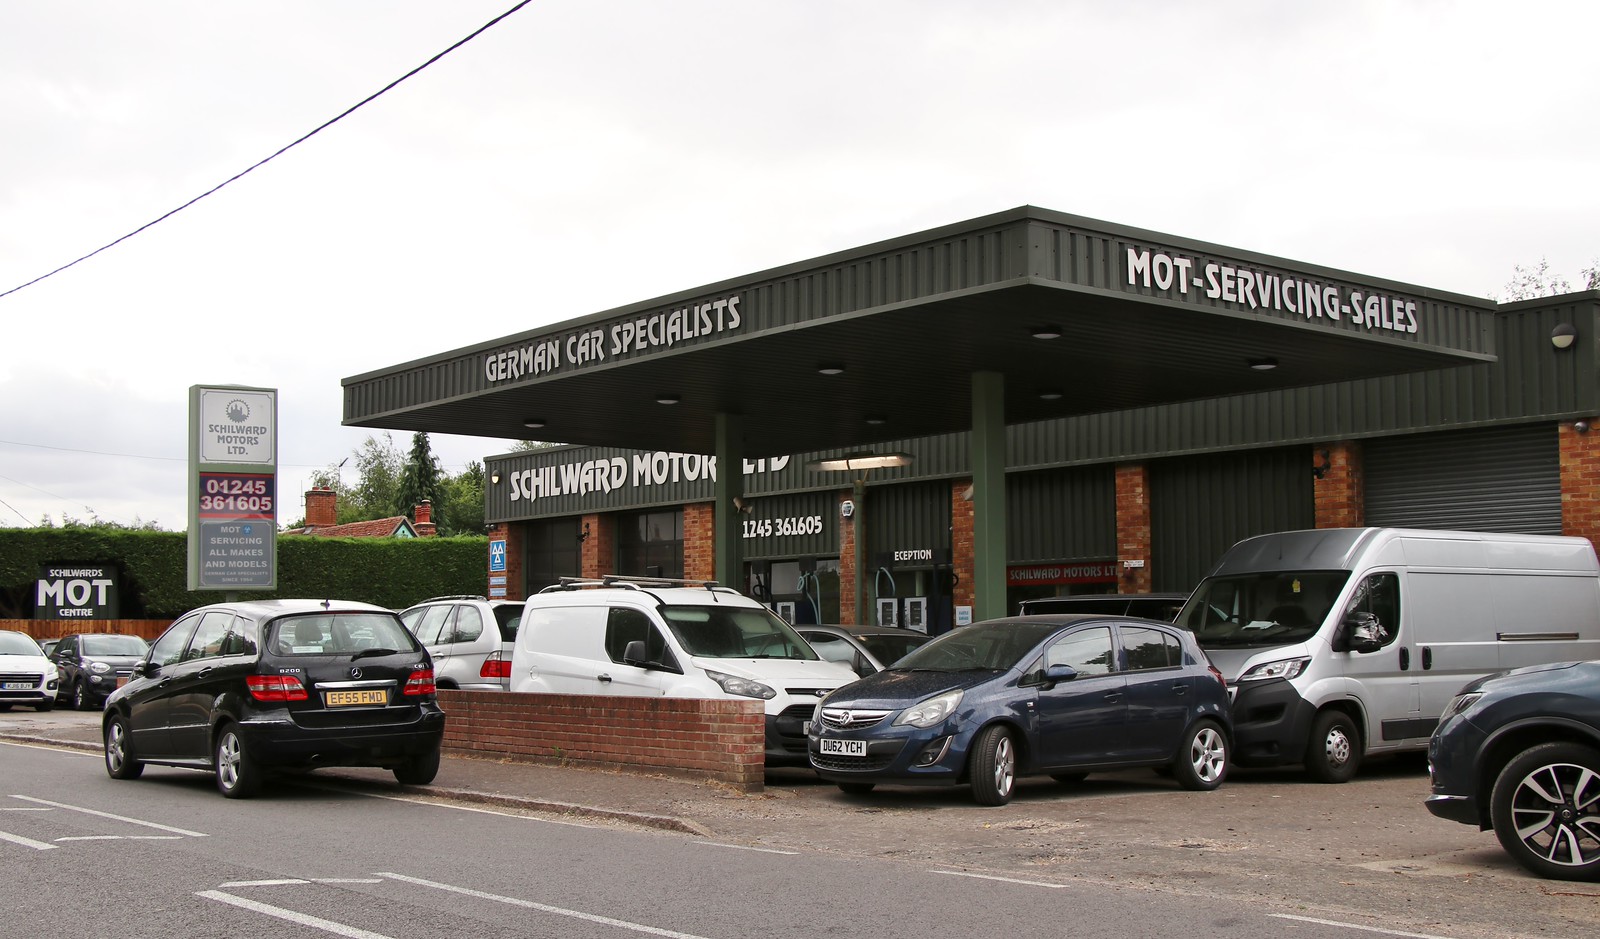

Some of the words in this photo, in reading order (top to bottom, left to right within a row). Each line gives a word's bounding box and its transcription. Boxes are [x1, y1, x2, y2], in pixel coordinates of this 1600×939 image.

[1127, 248, 1418, 333] MOT-SERVICING-SALES
[485, 339, 560, 382] GERMAN
[566, 329, 605, 366] CAR
[611, 296, 741, 356] SPECIALISTS
[208, 424, 267, 435] SCHILWARD
[217, 435, 259, 446] MOTORS
[227, 446, 248, 455] LTD.
[510, 457, 628, 503] SCHILWARD
[633, 451, 716, 487] MOTOR
[206, 479, 266, 495] 01245
[200, 495, 272, 511] 361605
[775, 515, 823, 537] 361605
[210, 537, 263, 545] SERVICING
[205, 560, 226, 568] AND
[228, 560, 268, 568] MODELS
[50, 569, 103, 577] SCHILWARDS
[1010, 567, 1060, 581] SCHILWARD
[1063, 566, 1101, 578] MOTORS
[37, 579, 113, 606] MOT
[59, 608, 93, 617] CENTRE
[330, 692, 359, 704] EF55
[361, 691, 383, 703] FMD
[823, 740, 842, 752] DU62
[844, 742, 862, 753] YCH
